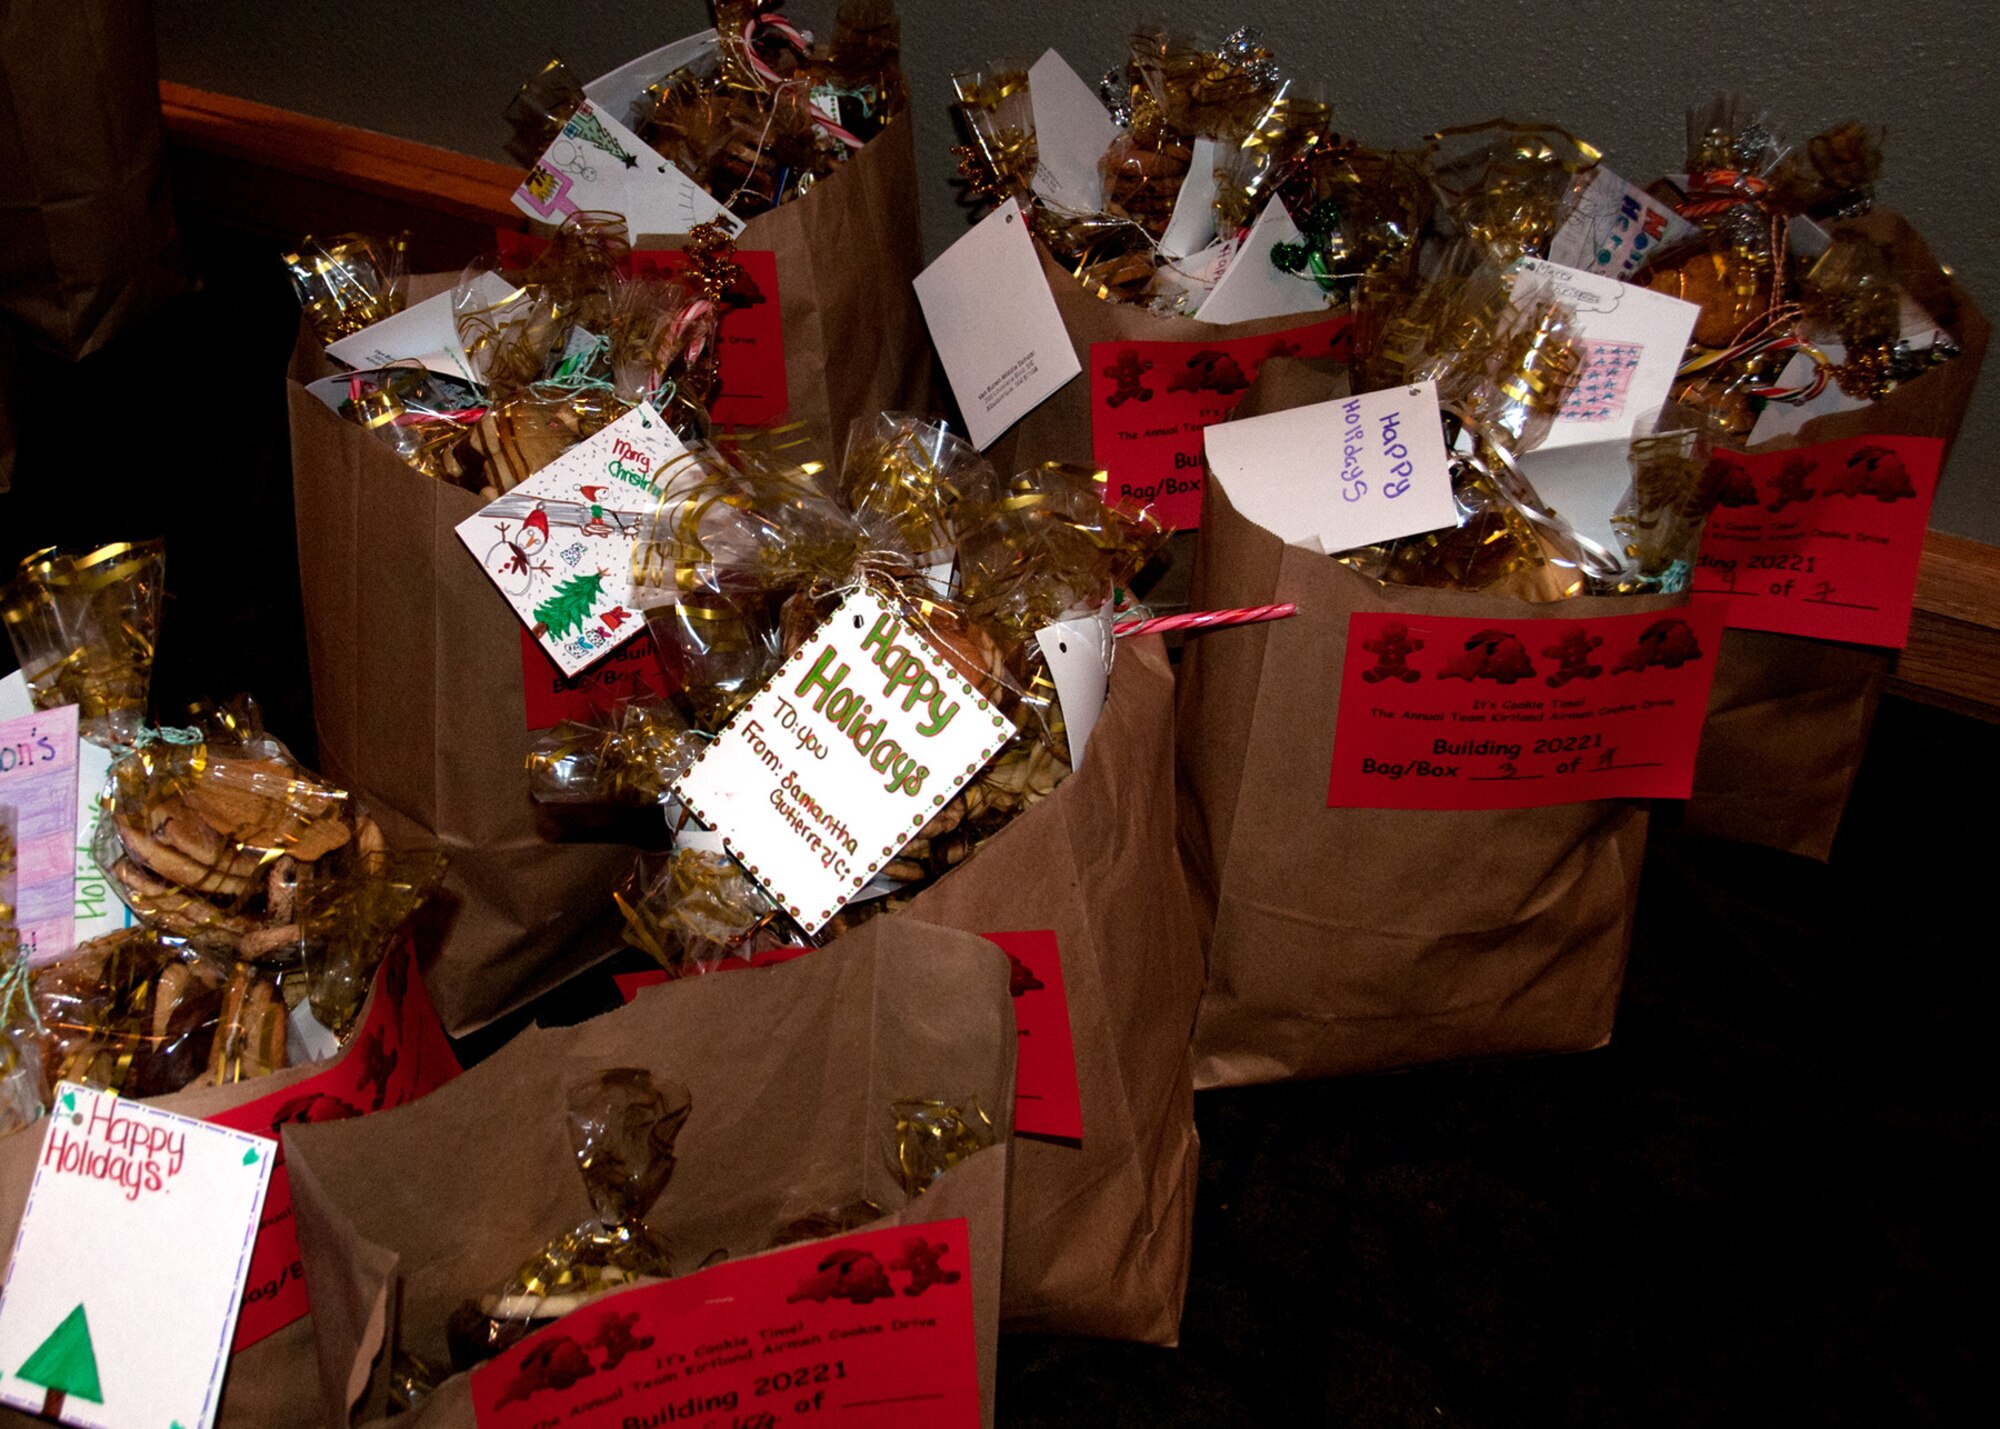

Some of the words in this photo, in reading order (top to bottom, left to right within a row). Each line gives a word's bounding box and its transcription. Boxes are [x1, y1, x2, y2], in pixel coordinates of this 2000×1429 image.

[1144, 424, 1178, 438] Annual
[1340, 398, 1368, 503] Holidays
[1378, 410, 1413, 499] Happy
[1747, 553, 1816, 574] 20221
[1769, 579, 1795, 598] of
[860, 611, 961, 738] Happy
[794, 643, 931, 798] Holidays
[1370, 707, 1395, 719] The
[1400, 709, 1446, 722] Annual
[1450, 711, 1487, 723] Team
[1472, 699, 1497, 711] It's
[1501, 700, 1544, 711] Cookie
[1551, 697, 1586, 709] Time!
[1432, 738, 1521, 761] Building
[1532, 732, 1604, 755] 20221
[1361, 757, 1460, 781] Bag/Box
[1555, 756, 1582, 775] of
[741, 719, 783, 777] From:
[780, 770, 858, 857] Samantha
[87, 1094, 185, 1175] Happy
[634, 1371, 678, 1392] Team
[828, 1324, 884, 1342] Cookie
[890, 1316, 937, 1332] Drive
[694, 1336, 749, 1358] Cookie
[759, 1321, 804, 1341] Time!
[622, 1391, 738, 1429] Building
[753, 1360, 848, 1397] 20221
[794, 1389, 826, 1414] of
